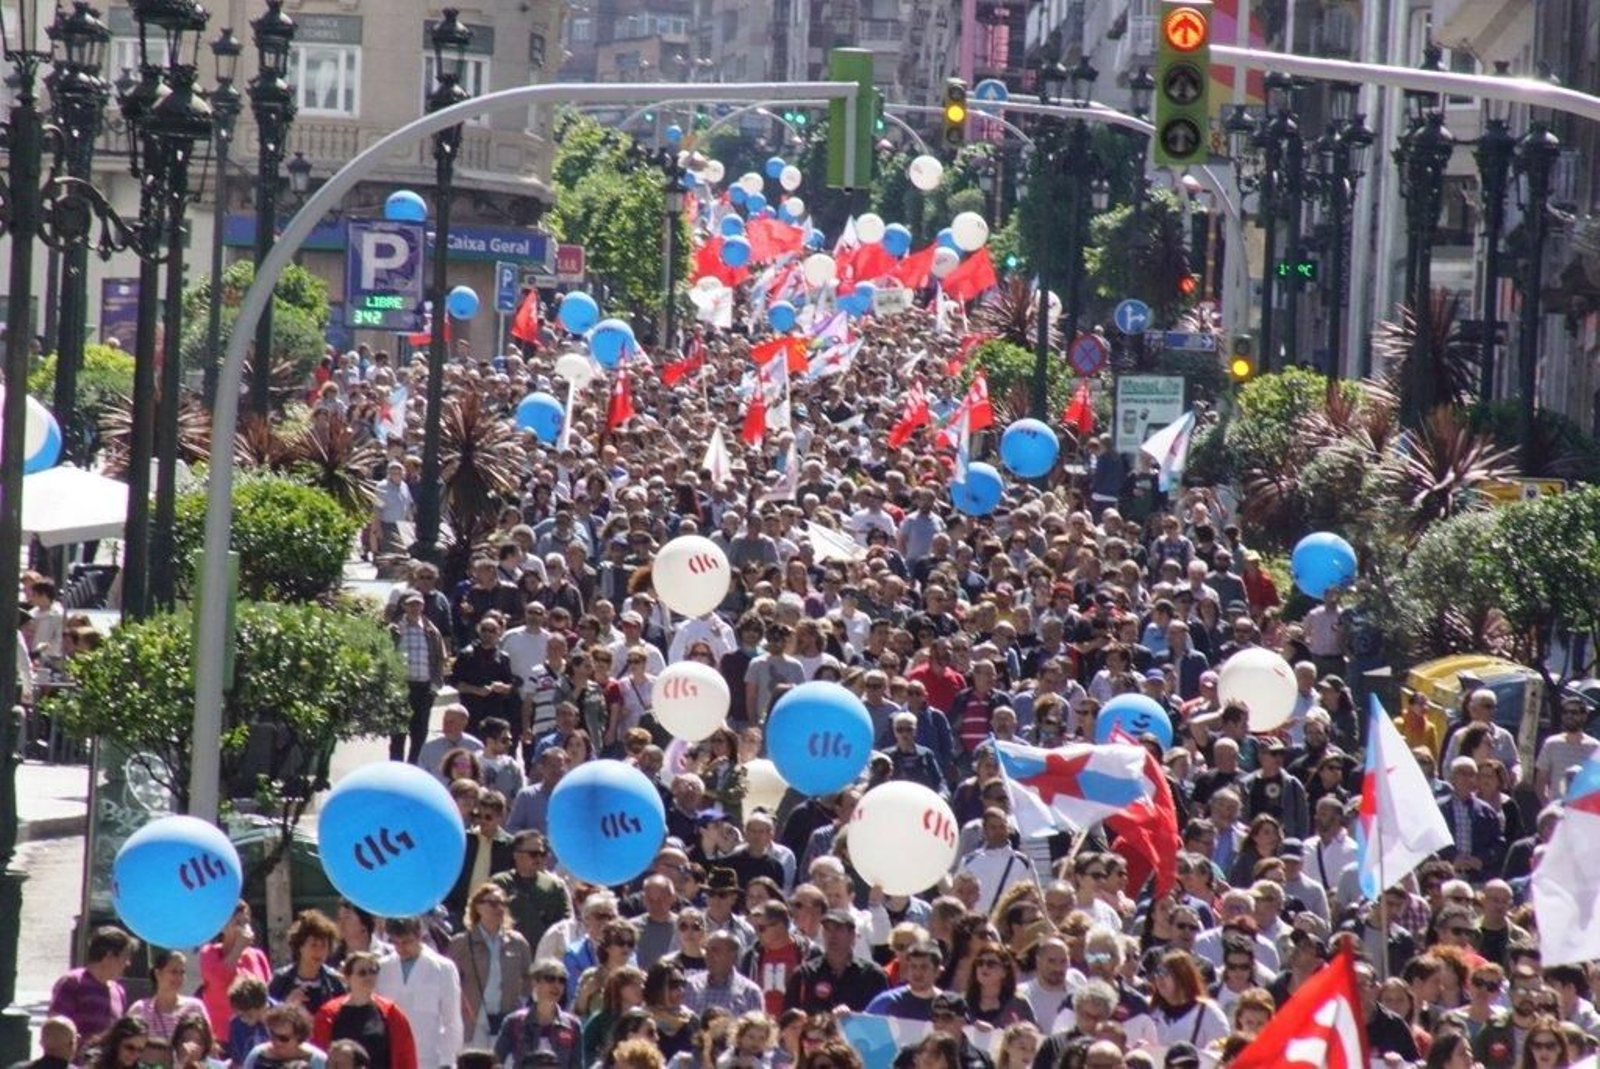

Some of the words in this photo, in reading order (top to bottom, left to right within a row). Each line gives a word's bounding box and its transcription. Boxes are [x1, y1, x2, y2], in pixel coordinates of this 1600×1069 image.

[447, 234, 486, 251] Caixa
[490, 238, 529, 255] Geral
[361, 232, 410, 290] P
[502, 269, 513, 287] P
[366, 296, 403, 309] LIBRE
[353, 310, 382, 324] 342
[688, 553, 718, 574] CIG
[663, 678, 698, 699] CIG
[808, 731, 853, 759] CIG
[601, 812, 643, 839] CIG
[923, 809, 956, 849] CIG
[354, 827, 415, 870] CIG
[179, 853, 227, 891] CIG
